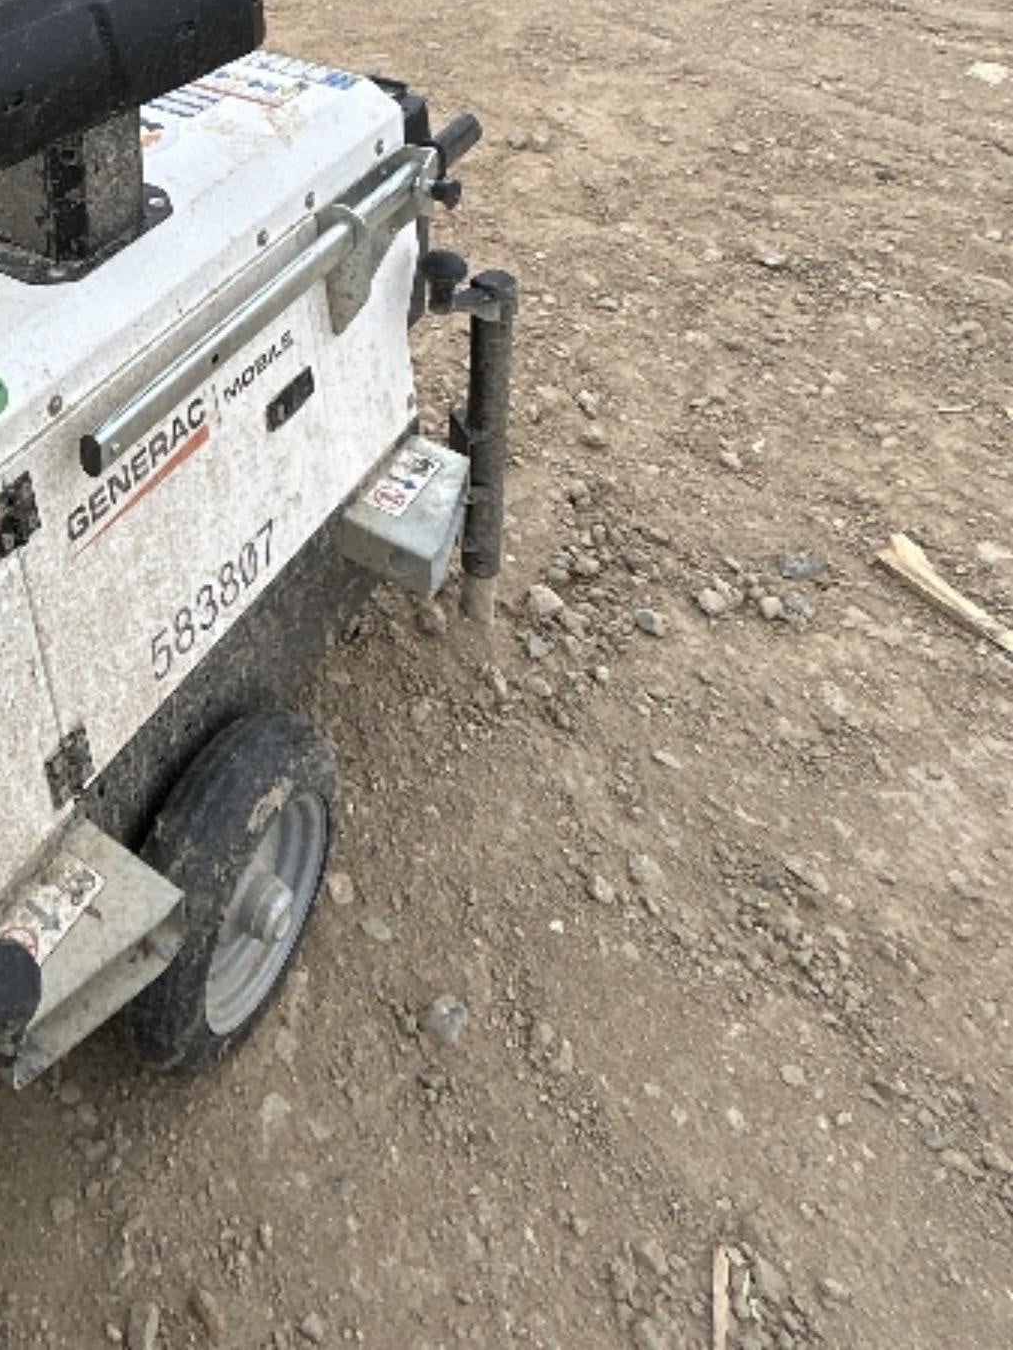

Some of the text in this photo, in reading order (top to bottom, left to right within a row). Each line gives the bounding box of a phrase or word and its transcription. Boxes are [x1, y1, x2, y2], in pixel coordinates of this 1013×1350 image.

[67, 329, 296, 542] GENERAC MOBILE
[151, 518, 274, 682] 583807
